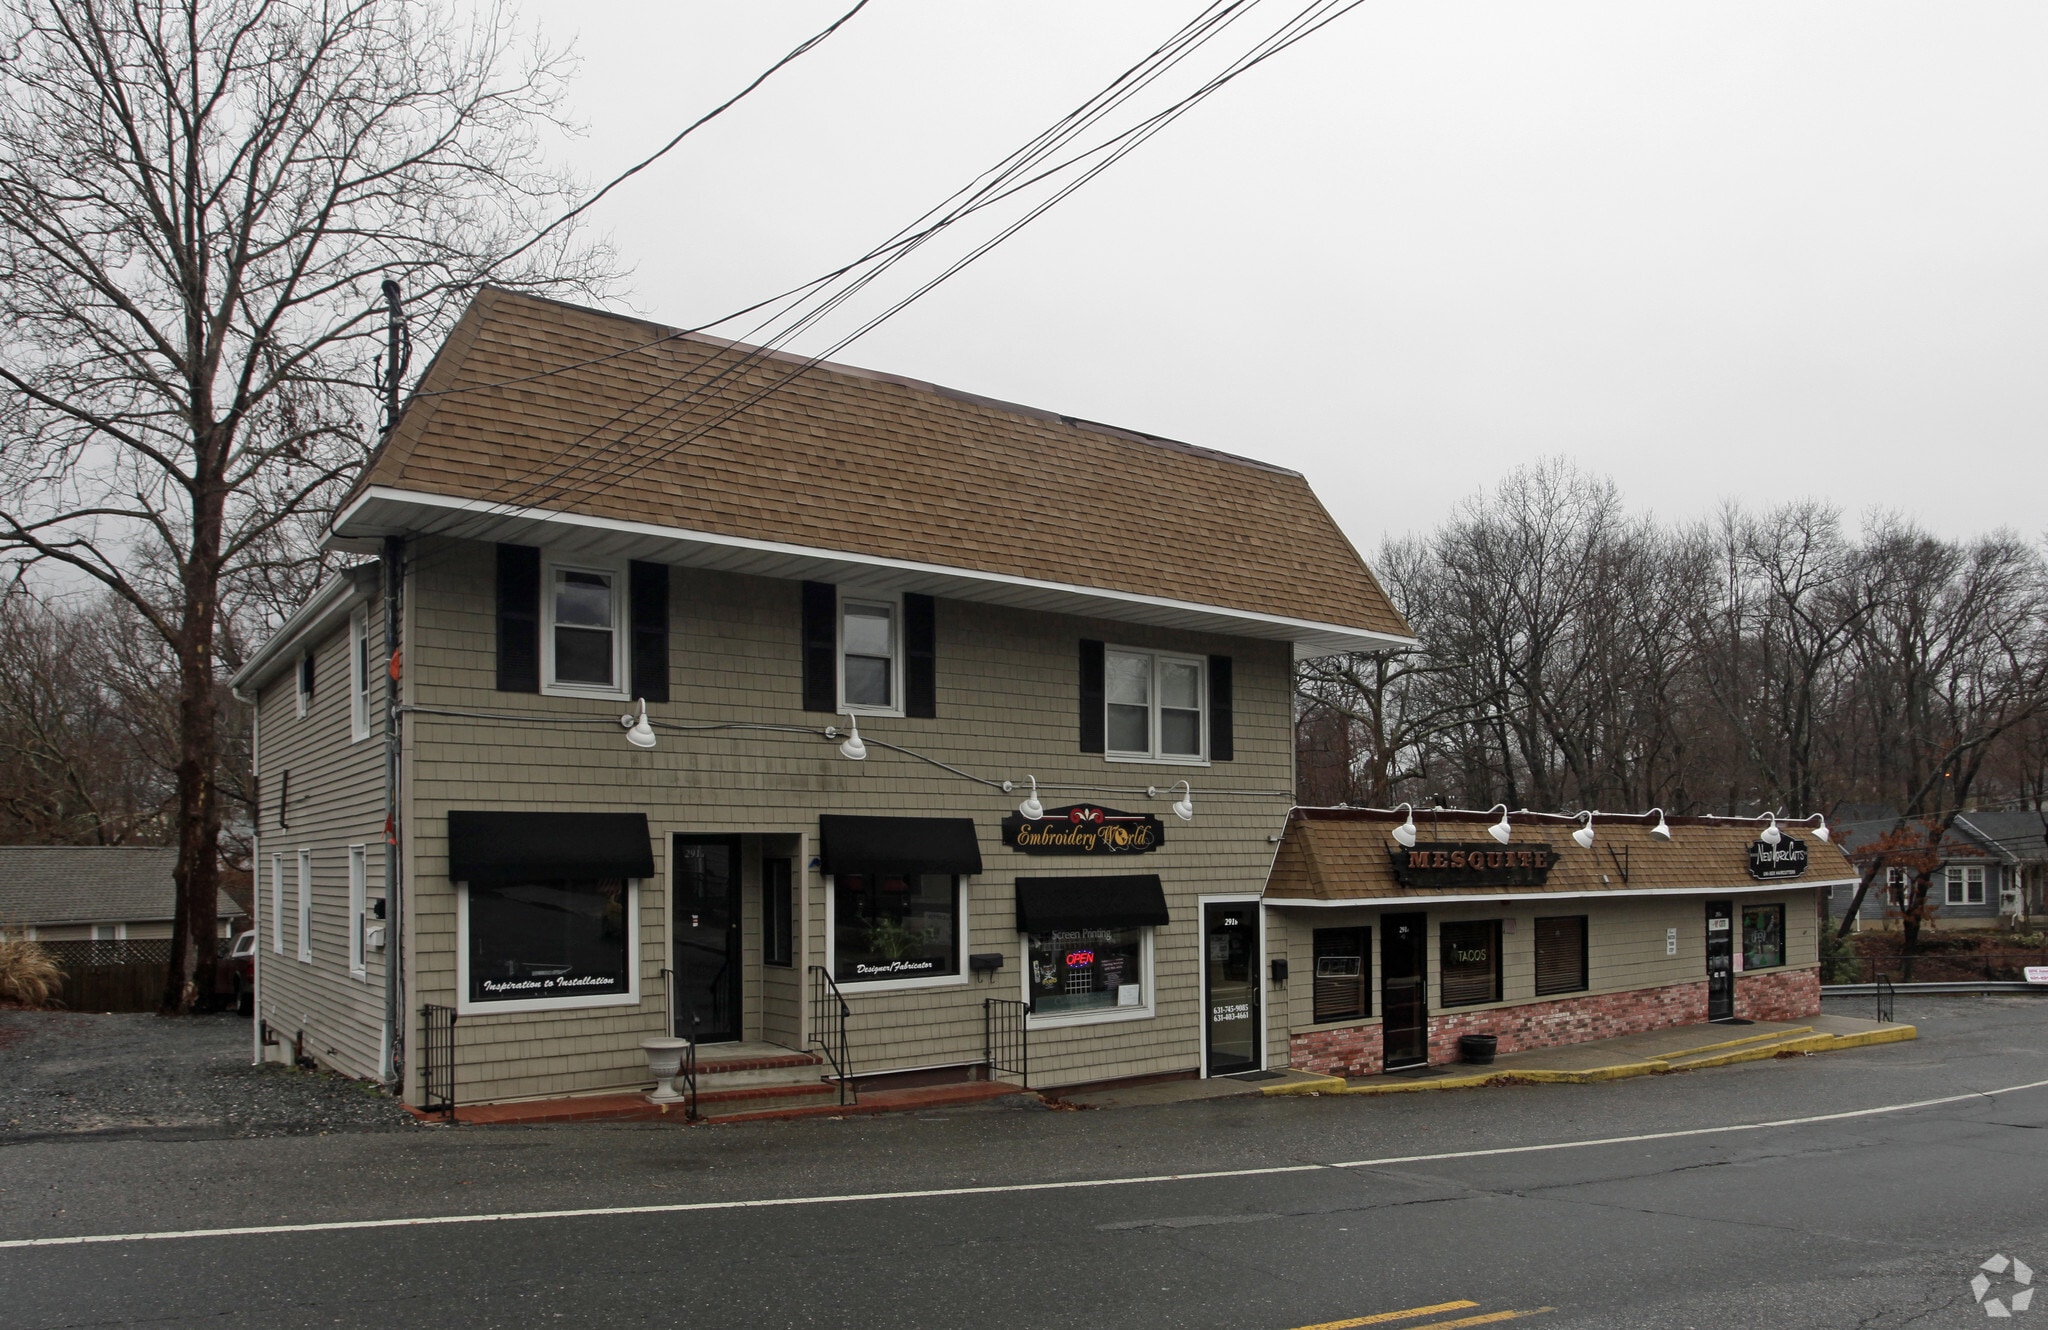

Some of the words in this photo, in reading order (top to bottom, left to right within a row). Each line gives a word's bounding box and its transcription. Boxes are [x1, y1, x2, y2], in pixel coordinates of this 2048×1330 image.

[1017, 823, 1097, 850] Embroidery
[1097, 824, 1152, 846] World
[1408, 851, 1548, 870] MESQUITE
[1052, 929, 1080, 940] Screen
[1082, 928, 1112, 941] Printing
[1066, 952, 1094, 965] OPEN
[1457, 949, 1487, 962] TACOS
[857, 961, 933, 974] Designer/Fabricator
[484, 979, 541, 992] Inspiration
[543, 979, 554, 988] to
[556, 976, 615, 987] Installation
